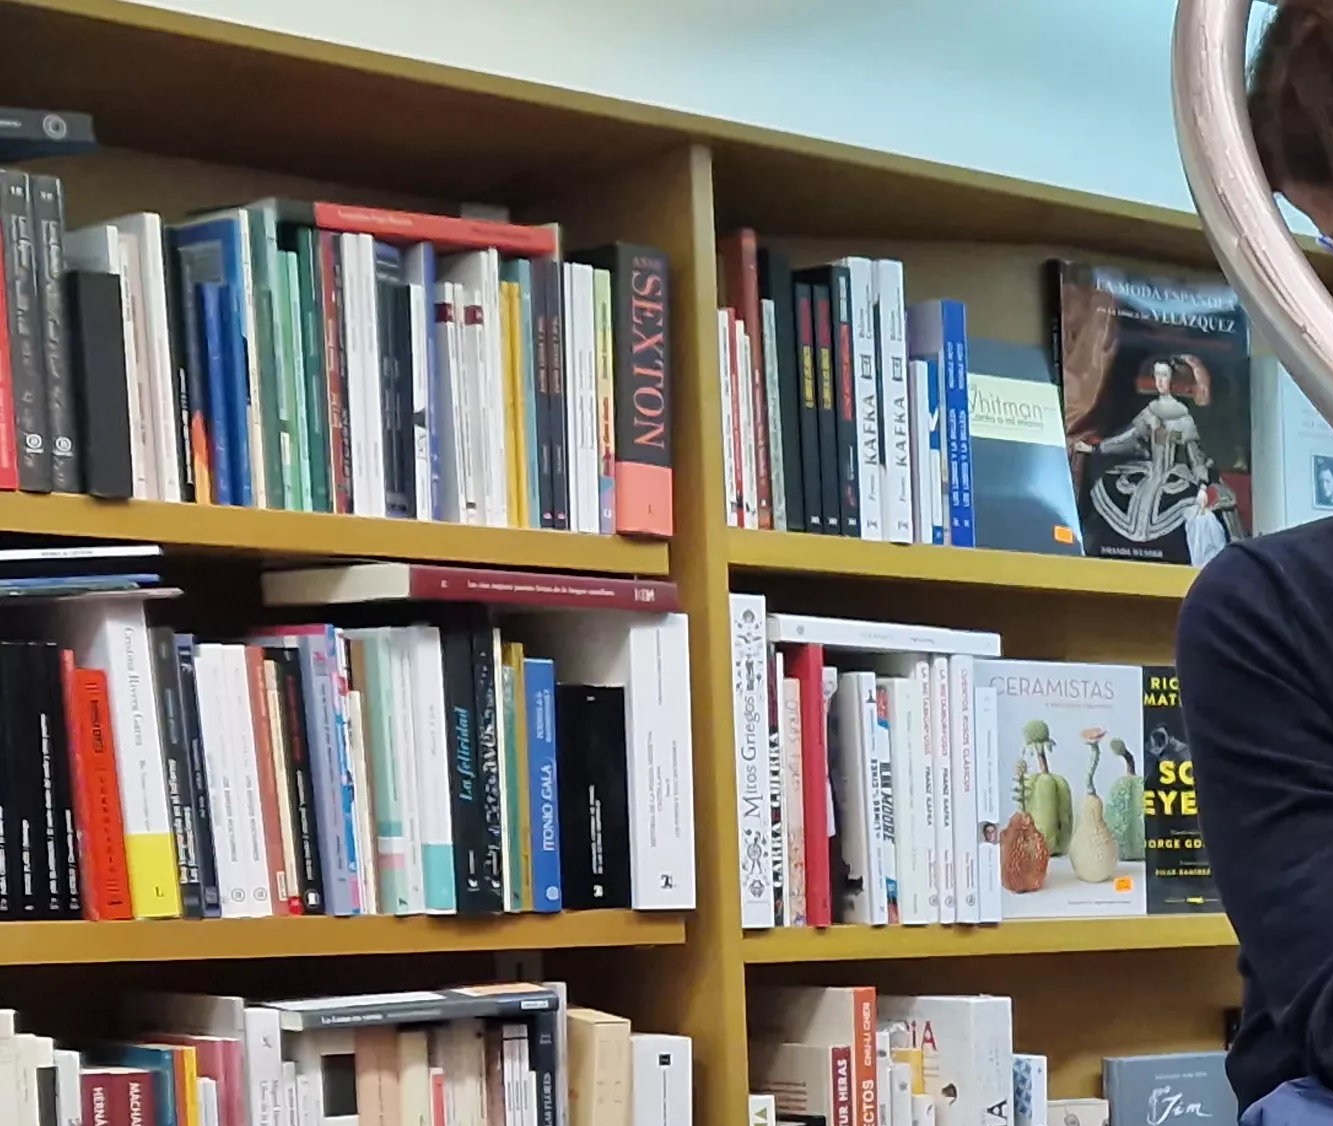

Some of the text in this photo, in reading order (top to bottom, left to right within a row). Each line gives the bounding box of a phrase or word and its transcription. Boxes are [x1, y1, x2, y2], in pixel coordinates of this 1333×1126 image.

[1115, 281, 1161, 301] MODA
[1151, 308, 1236, 333] VELÁZQUEZ
[631, 271, 665, 449] SEXTON
[862, 394, 878, 466] KAFKA
[893, 396, 908, 467] KAFKA
[990, 676, 1115, 700] CERAMISTAS
[1144, 692, 1182, 706] MAT
[453, 704, 475, 801] La felicidad
[740, 695, 763, 818] Mitos Griegos
[540, 762, 553, 802] GALA
[541, 803, 556, 850] TONIO
[1184, 838, 1207, 849] GO
[837, 1059, 849, 1103] HERAS
